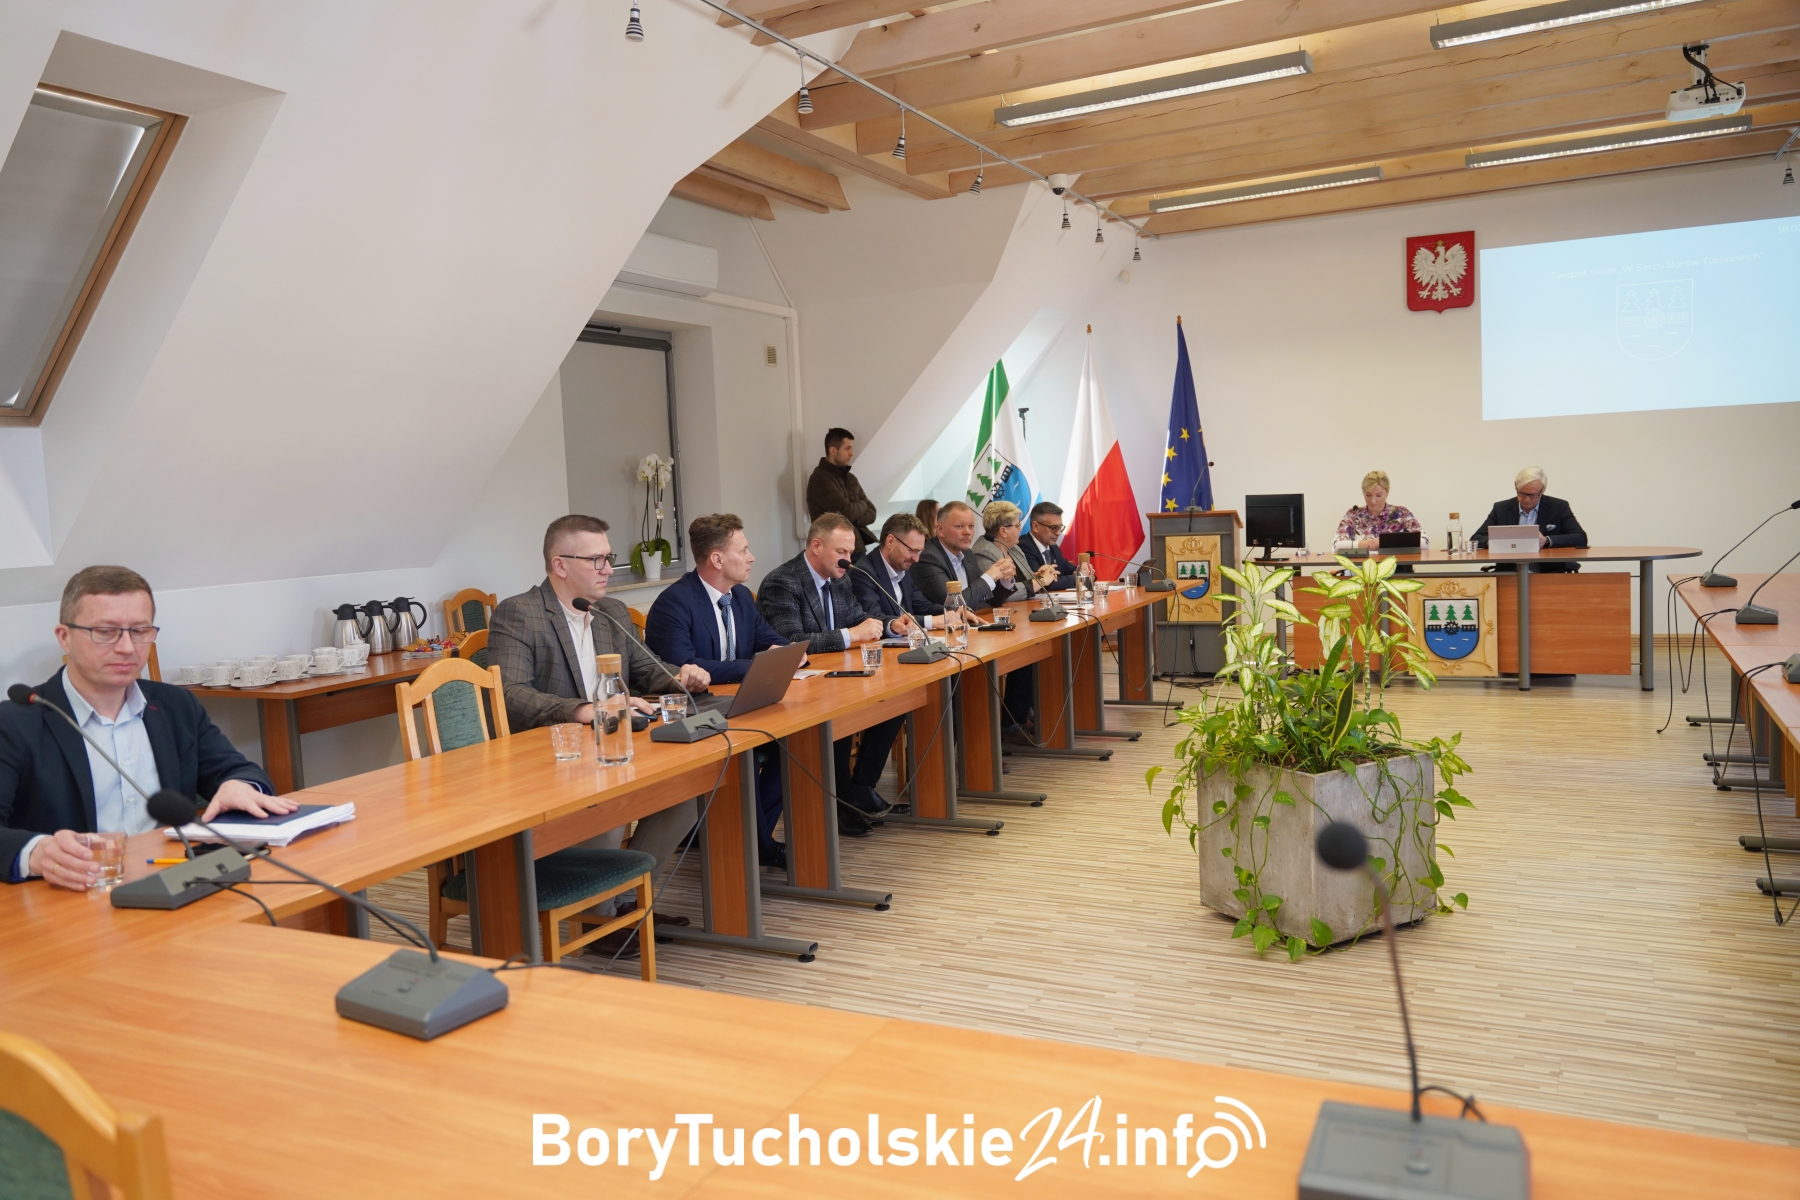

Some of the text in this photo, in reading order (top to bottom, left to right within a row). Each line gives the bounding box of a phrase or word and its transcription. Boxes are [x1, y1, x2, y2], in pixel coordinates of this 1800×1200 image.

[1551, 270, 1588, 280] Związek
[1591, 267, 1616, 275] Gmin
[1636, 263, 1664, 272] Sercu
[1667, 260, 1699, 268] Borów
